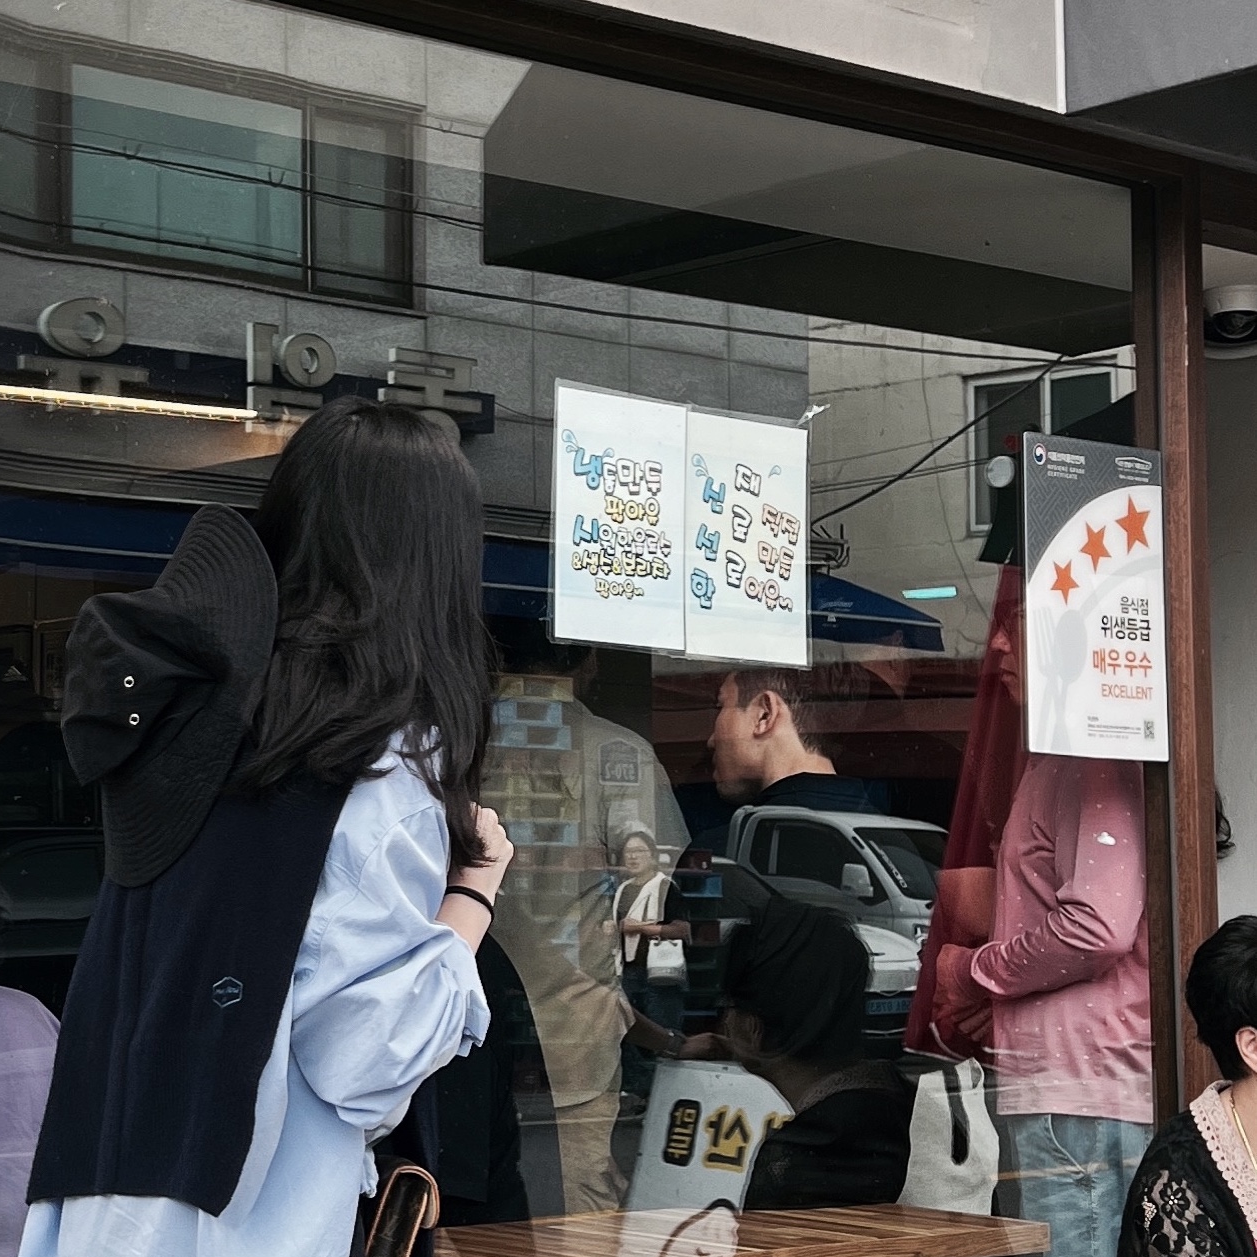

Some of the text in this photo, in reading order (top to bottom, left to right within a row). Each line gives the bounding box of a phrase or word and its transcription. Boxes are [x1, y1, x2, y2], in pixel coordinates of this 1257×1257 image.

[604, 495, 660, 526] 팔아유
[1120, 596, 1149, 616] 음식점
[1101, 615, 1151, 641] 위생등급
[1093, 647, 1152, 678] 매우 우수
[1101, 683, 1153, 700] EXCELLENT
